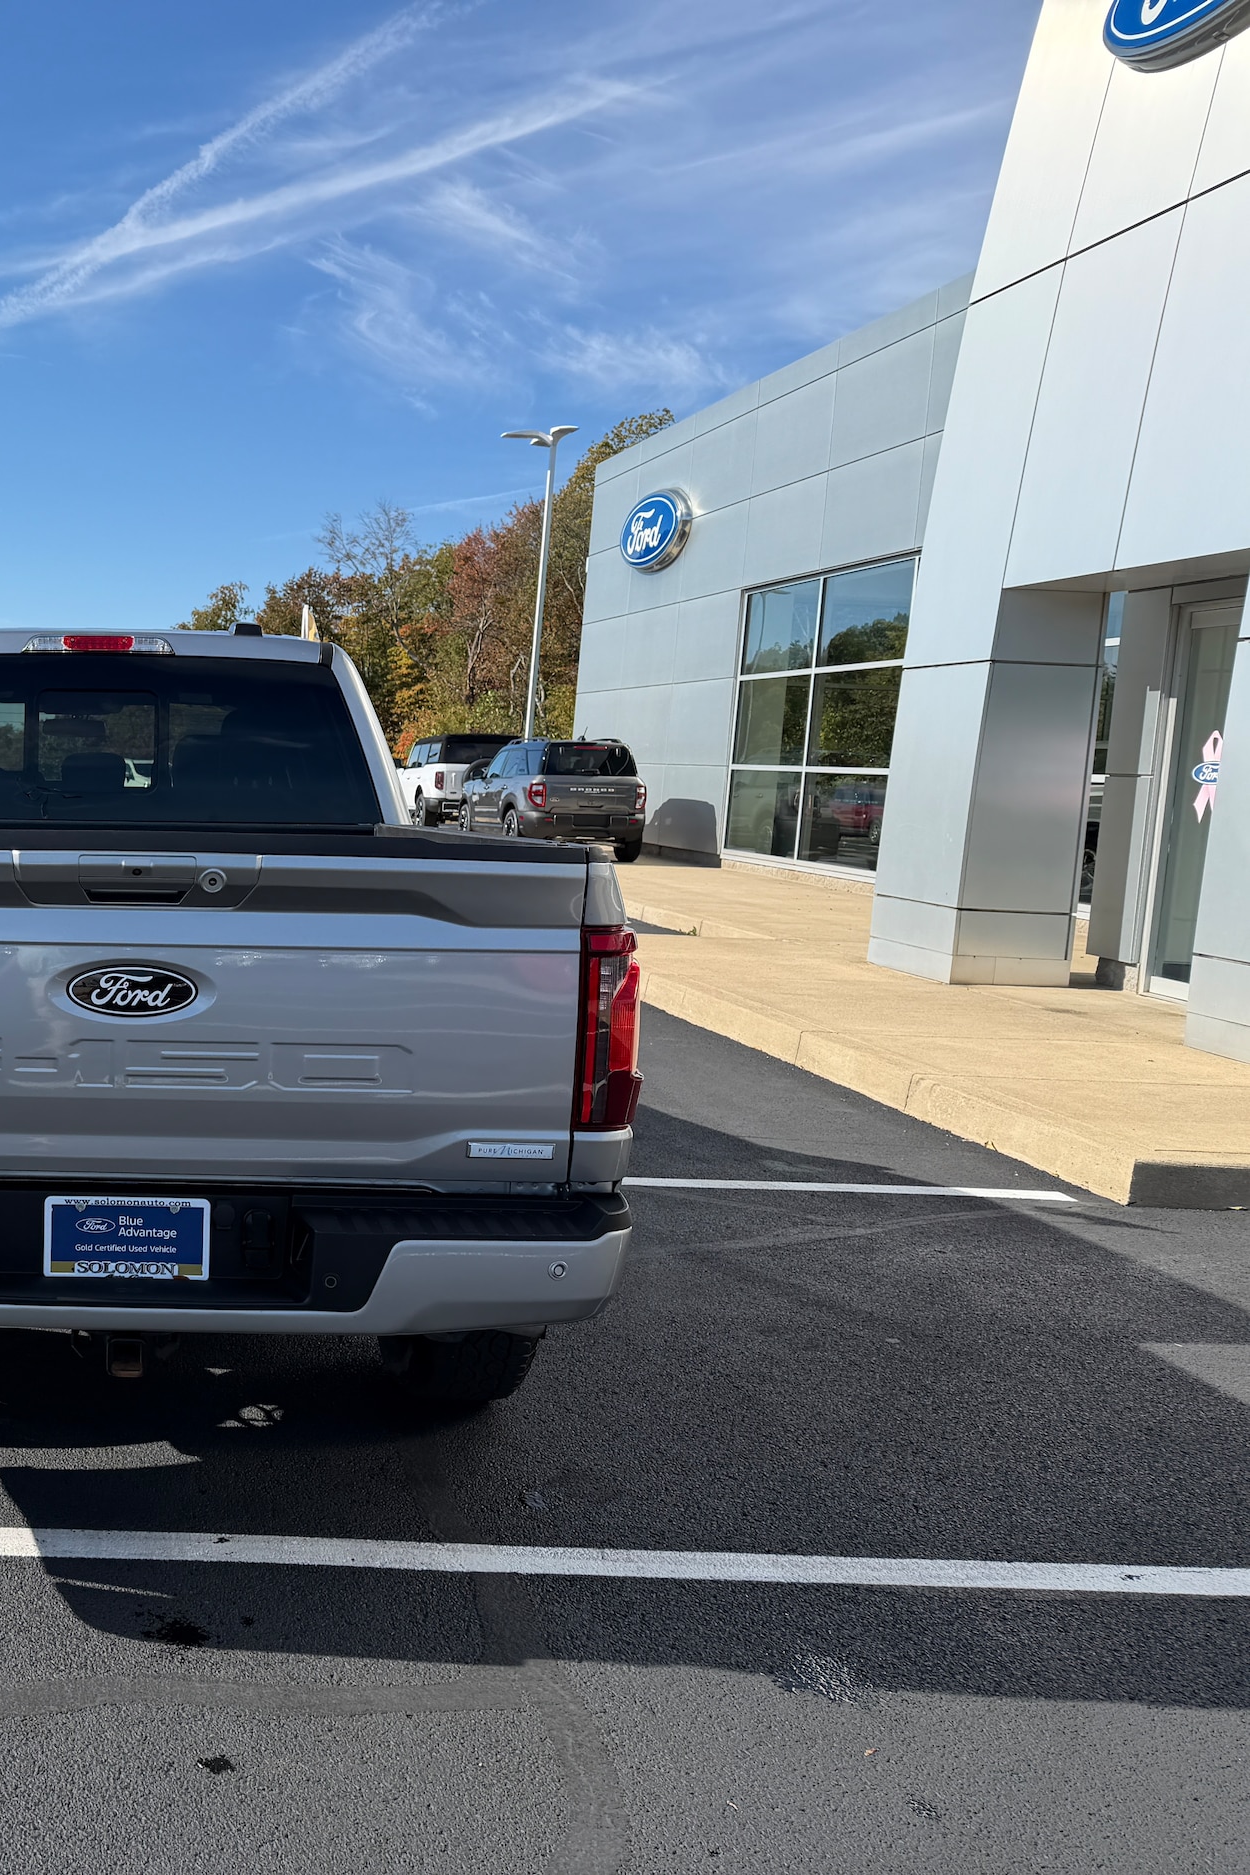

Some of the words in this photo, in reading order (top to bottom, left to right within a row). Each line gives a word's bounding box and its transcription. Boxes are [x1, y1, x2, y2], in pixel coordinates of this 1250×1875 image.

[627, 508, 663, 555] Ford
[1199, 765, 1219, 780] For
[91, 973, 174, 1007] Ford
[64, 1198, 192, 1207] www.solomonauto.com
[83, 1219, 108, 1231] Ford
[118, 1216, 144, 1226] Blue
[118, 1228, 177, 1239] Advantage
[75, 1244, 93, 1252] Gold
[94, 1244, 126, 1253] Certified
[128, 1245, 148, 1253] Used
[150, 1245, 177, 1254] Vehicle
[77, 1262, 176, 1276] SOLOMON
